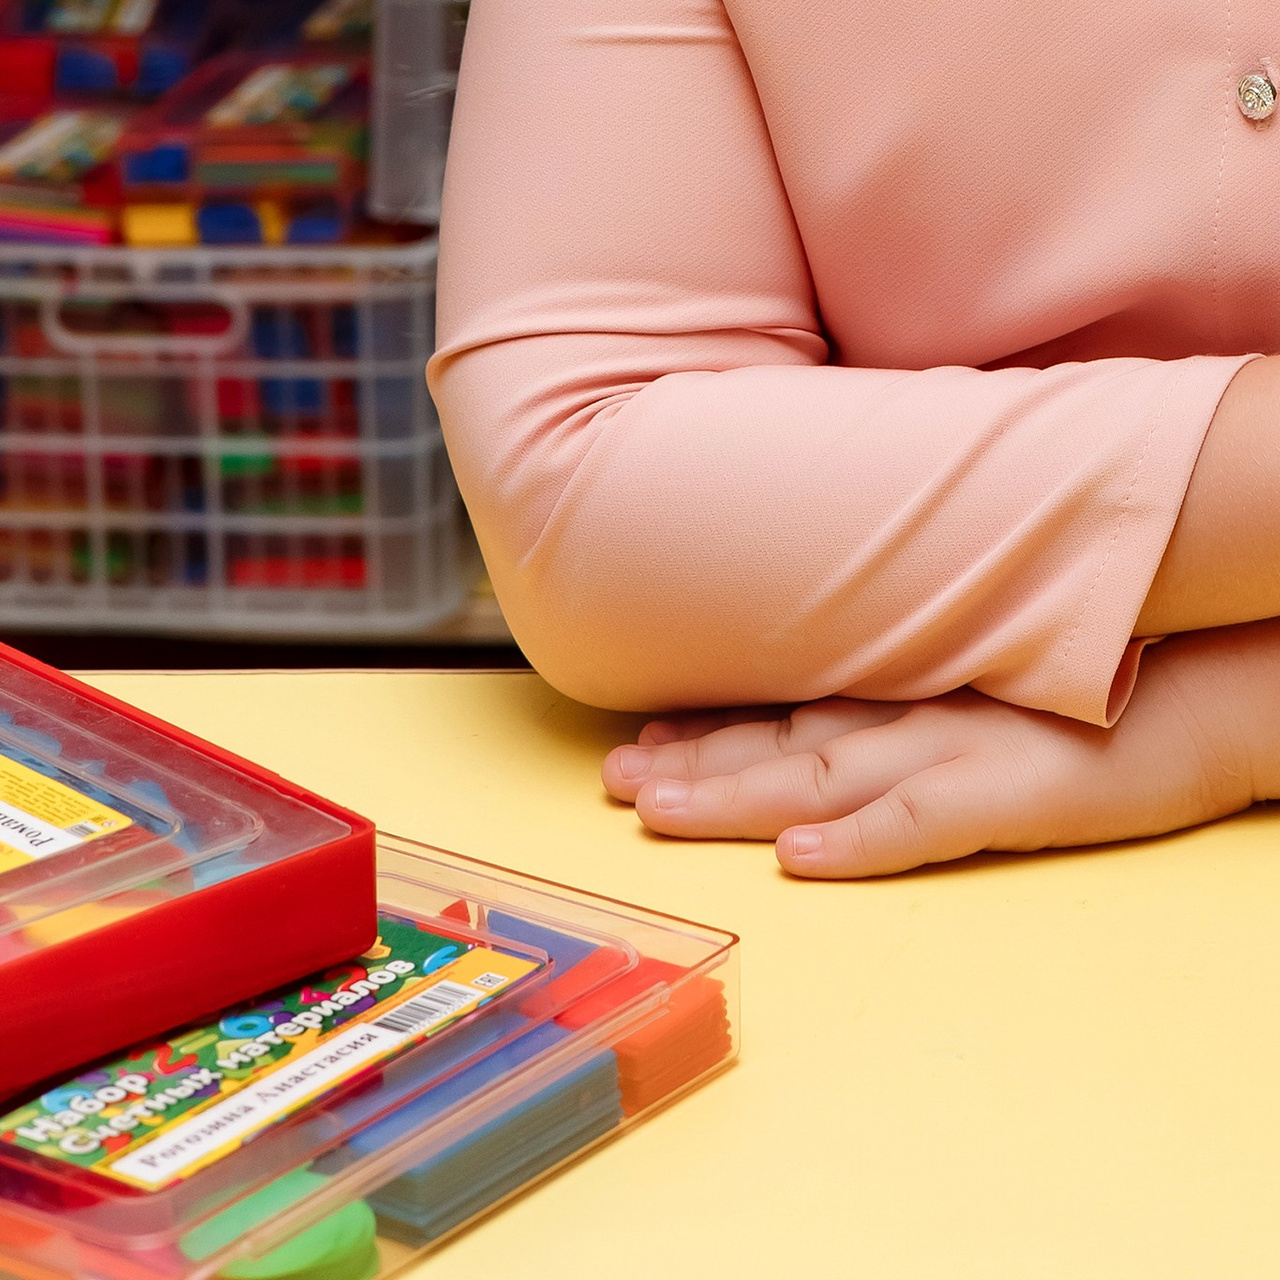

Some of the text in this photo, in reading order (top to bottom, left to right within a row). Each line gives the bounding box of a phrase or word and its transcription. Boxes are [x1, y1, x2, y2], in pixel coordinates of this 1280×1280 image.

[16, 1073, 149, 1143] Набор
[58, 1068, 224, 1155] Счетных
[216, 959, 416, 1070] материалов
[139, 1031, 380, 1168] Рогозина Анастасия
